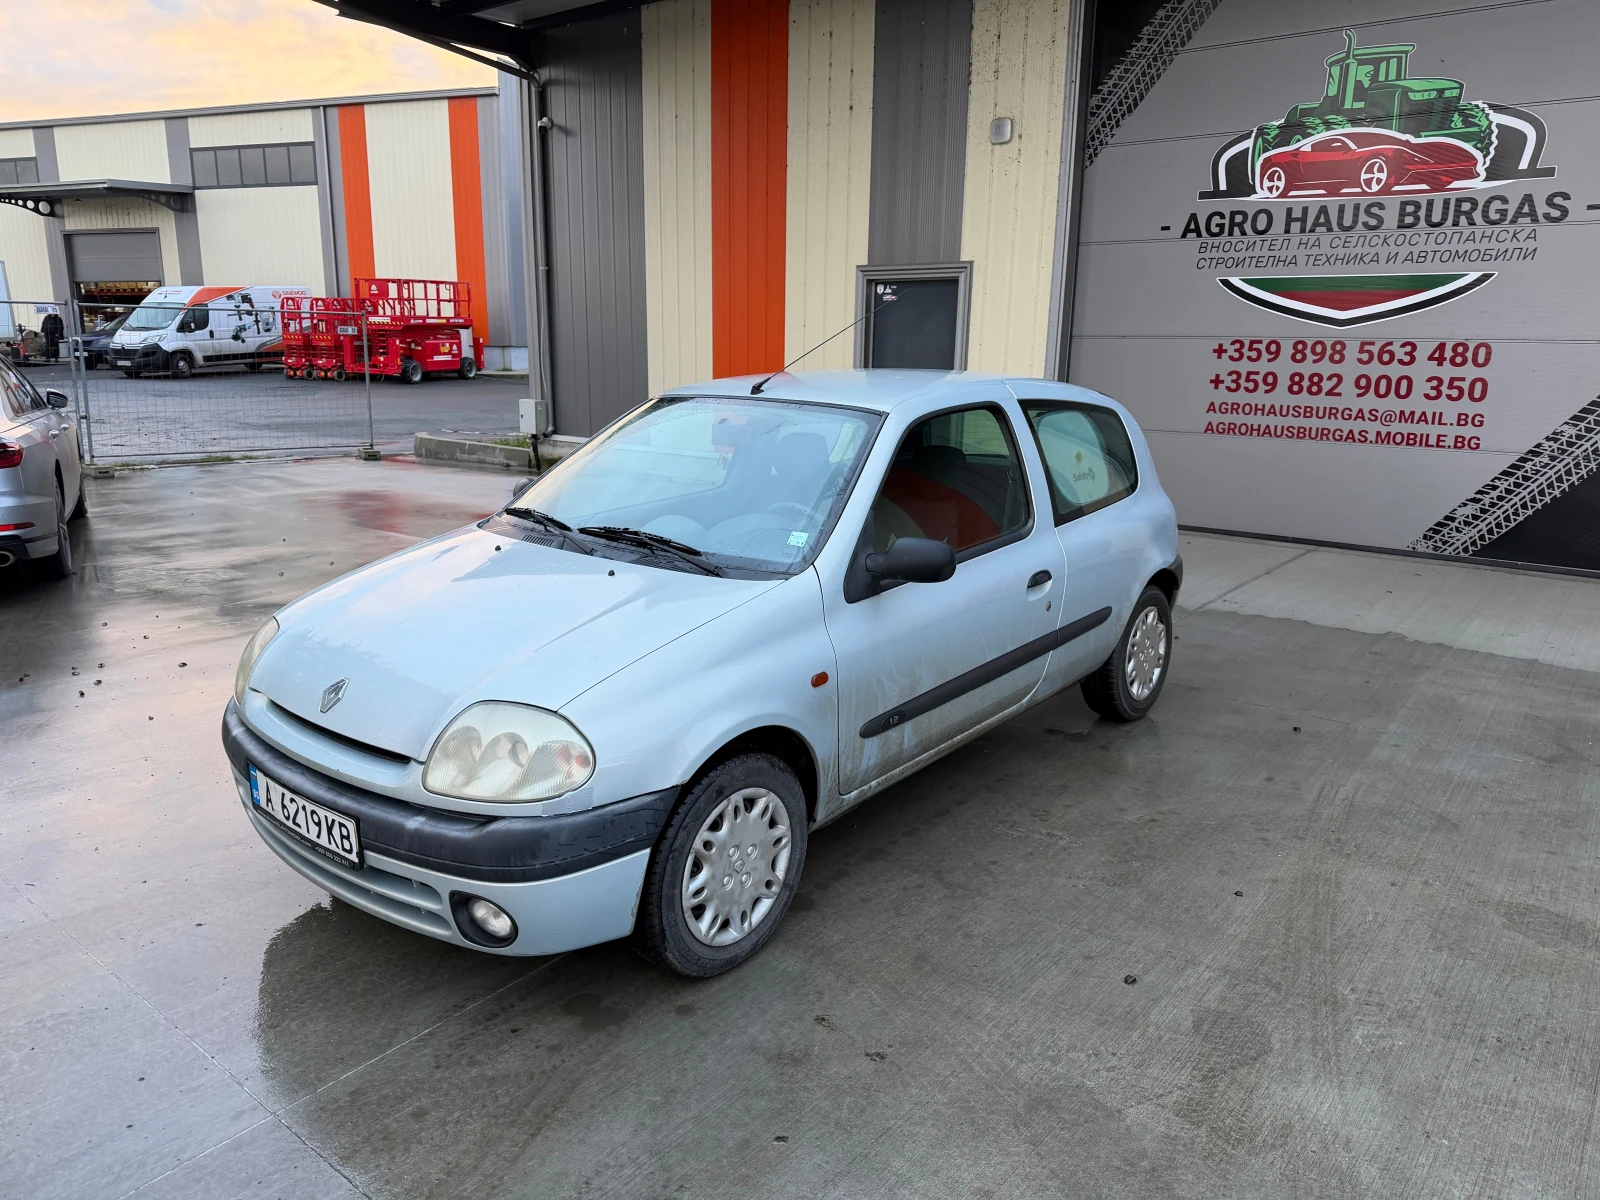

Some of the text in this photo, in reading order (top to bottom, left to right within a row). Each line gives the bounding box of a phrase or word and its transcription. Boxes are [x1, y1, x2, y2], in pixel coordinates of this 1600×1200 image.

[1180, 191, 1572, 239] AGRO HAUS BURGAS
[1198, 228, 1538, 254] ВНОСИТЕЛ НА СЕЛСКОСТОПАНСКА
[1196, 246, 1538, 270] СТРОИТЕЛНА ТЕХНИКА И АВТОМОБИЛИ
[1212, 339, 1493, 368] +359 898 563 480
[1209, 370, 1489, 403] +359 882 900 350
[1205, 401, 1485, 428] AGROHAUSBURGAS@MAIL.BG
[1203, 421, 1482, 451] AGROHAUSBURGAS.MOBILE.BG
[1072, 471, 1089, 482] Safety
